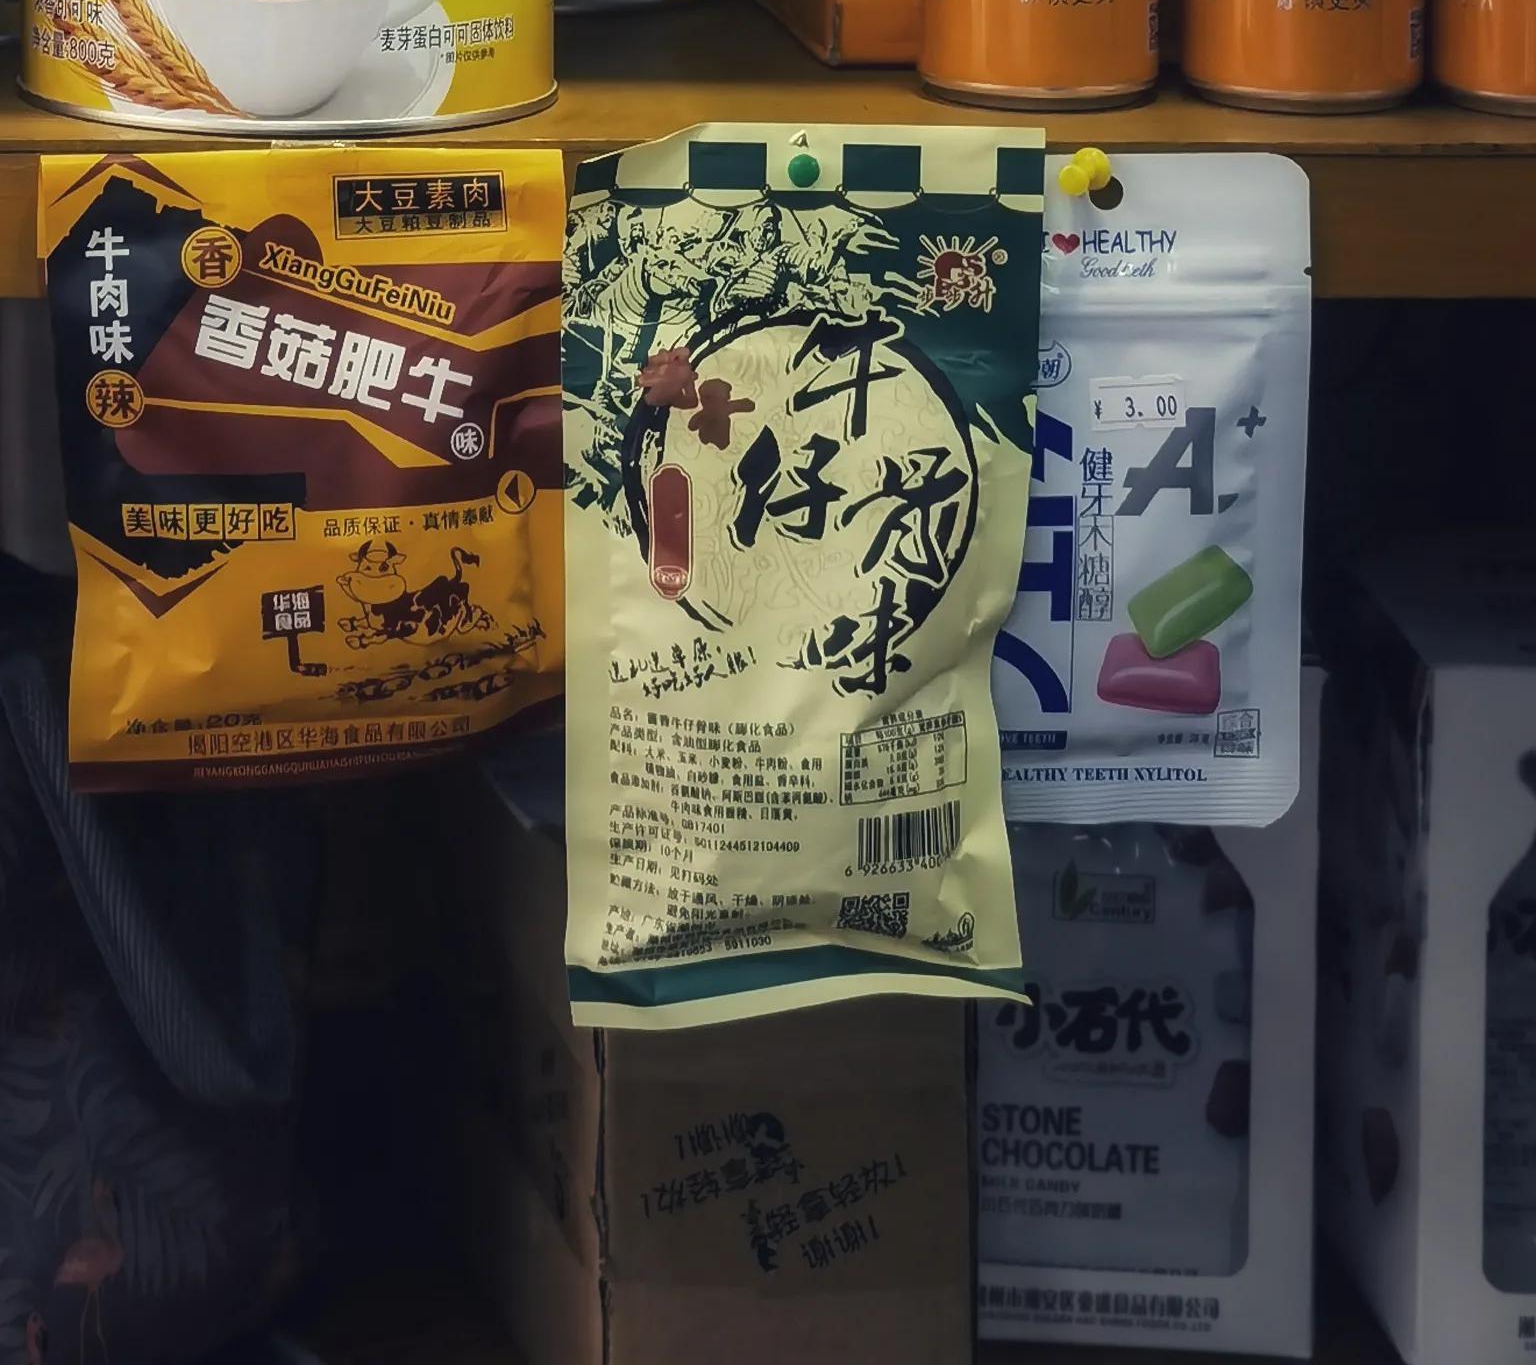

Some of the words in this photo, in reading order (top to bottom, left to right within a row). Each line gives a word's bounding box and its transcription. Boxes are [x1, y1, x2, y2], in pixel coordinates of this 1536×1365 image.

[380, 15, 514, 53] 麦芽蛋白可可固体饮料
[354, 177, 491, 213] 大豆素肉
[190, 234, 234, 281] 香
[1082, 229, 1177, 255] HEALTHY
[84, 226, 134, 365] 牛肉味
[259, 242, 456, 325] XiangGuFeiNiu
[192, 292, 475, 425] 香菇肥牛
[94, 378, 137, 421] 辣
[1124, 395, 1178, 420] 3.00
[454, 427, 481, 457] 味
[124, 506, 292, 537] 美味更好吃
[1076, 446, 1115, 621] 健牙木糖醇
[273, 610, 311, 630] 食品
[187, 716, 473, 758] 揭阳空港区华海食品有限公司
[1002, 767, 1067, 783] EALTHY
[1072, 768, 1130, 782] TEETH
[1133, 767, 1208, 783] XYLITOL
[995, 982, 1192, 1057] 小石代
[982, 1104, 1082, 1138] STONE
[982, 1139, 1161, 1176] CHOCOLATE
